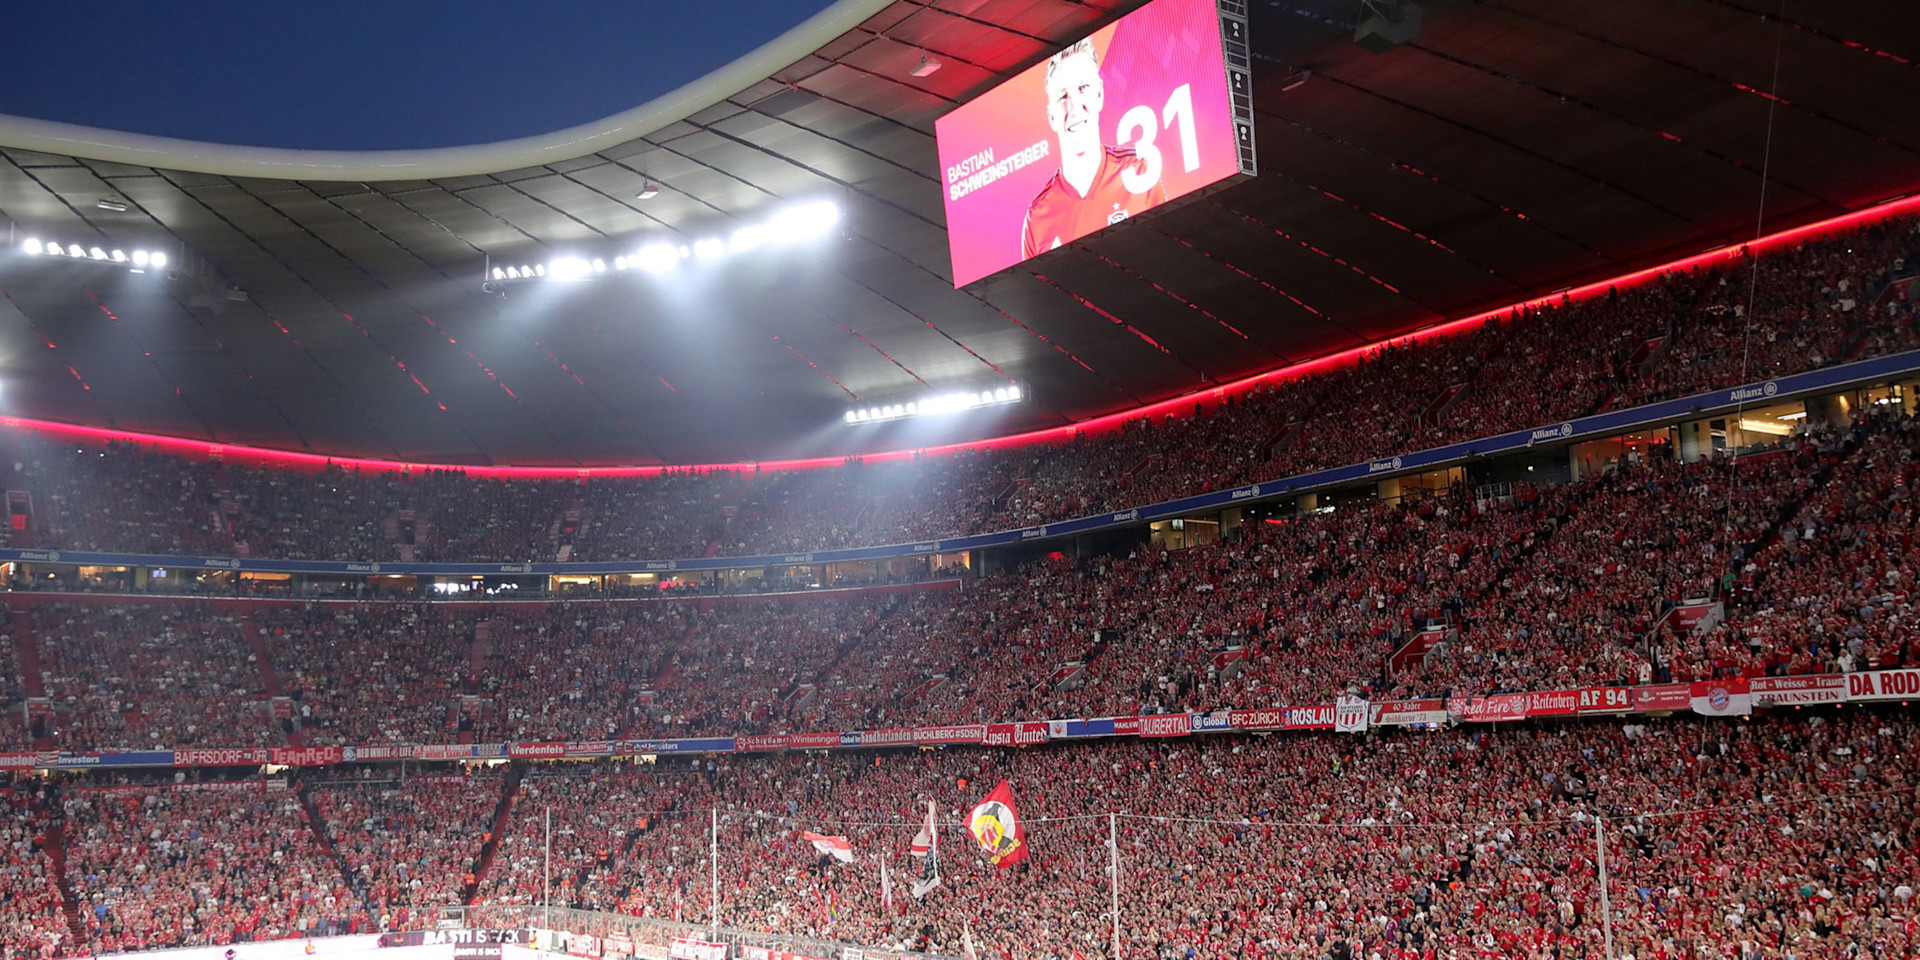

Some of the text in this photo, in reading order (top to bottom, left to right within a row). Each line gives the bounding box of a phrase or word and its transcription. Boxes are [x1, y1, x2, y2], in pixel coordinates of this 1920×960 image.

[1116, 82, 1201, 194] 31
[947, 147, 995, 184] BASTIAN
[949, 139, 1050, 201] SCHWEINSTEIGER
[1730, 387, 1763, 401] Allianz
[1532, 430, 1559, 440] Allianz
[1369, 462, 1391, 472] Allianz
[1232, 490, 1251, 499] Allianz
[1113, 513, 1131, 521] Allianz
[1022, 529, 1040, 538] Allianz
[205, 559, 229, 567] Allianz
[1751, 680, 1767, 690] Rot
[1774, 679, 1807, 689] Weisse
[1849, 672, 1919, 696] DA ROD
[1580, 689, 1628, 707] AF 94
[1759, 691, 1839, 703] TRAUNSTEIN
[1464, 698, 1510, 715] Red Fire
[1231, 713, 1248, 725] BFC
[1249, 711, 1280, 724] ZÜRICH
[1291, 707, 1335, 726] RÖSLAU
[1139, 716, 1190, 735] TAUBERTAL
[792, 735, 840, 744] Winterlingen
[981, 723, 1048, 745] Lipsia United
[357, 748, 369, 758] RED
[370, 747, 390, 758] WHITE
[399, 746, 411, 757] LIFE
[58, 756, 100, 764] Investors
[424, 930, 472, 945] BASTI
[476, 930, 487, 943] IS
